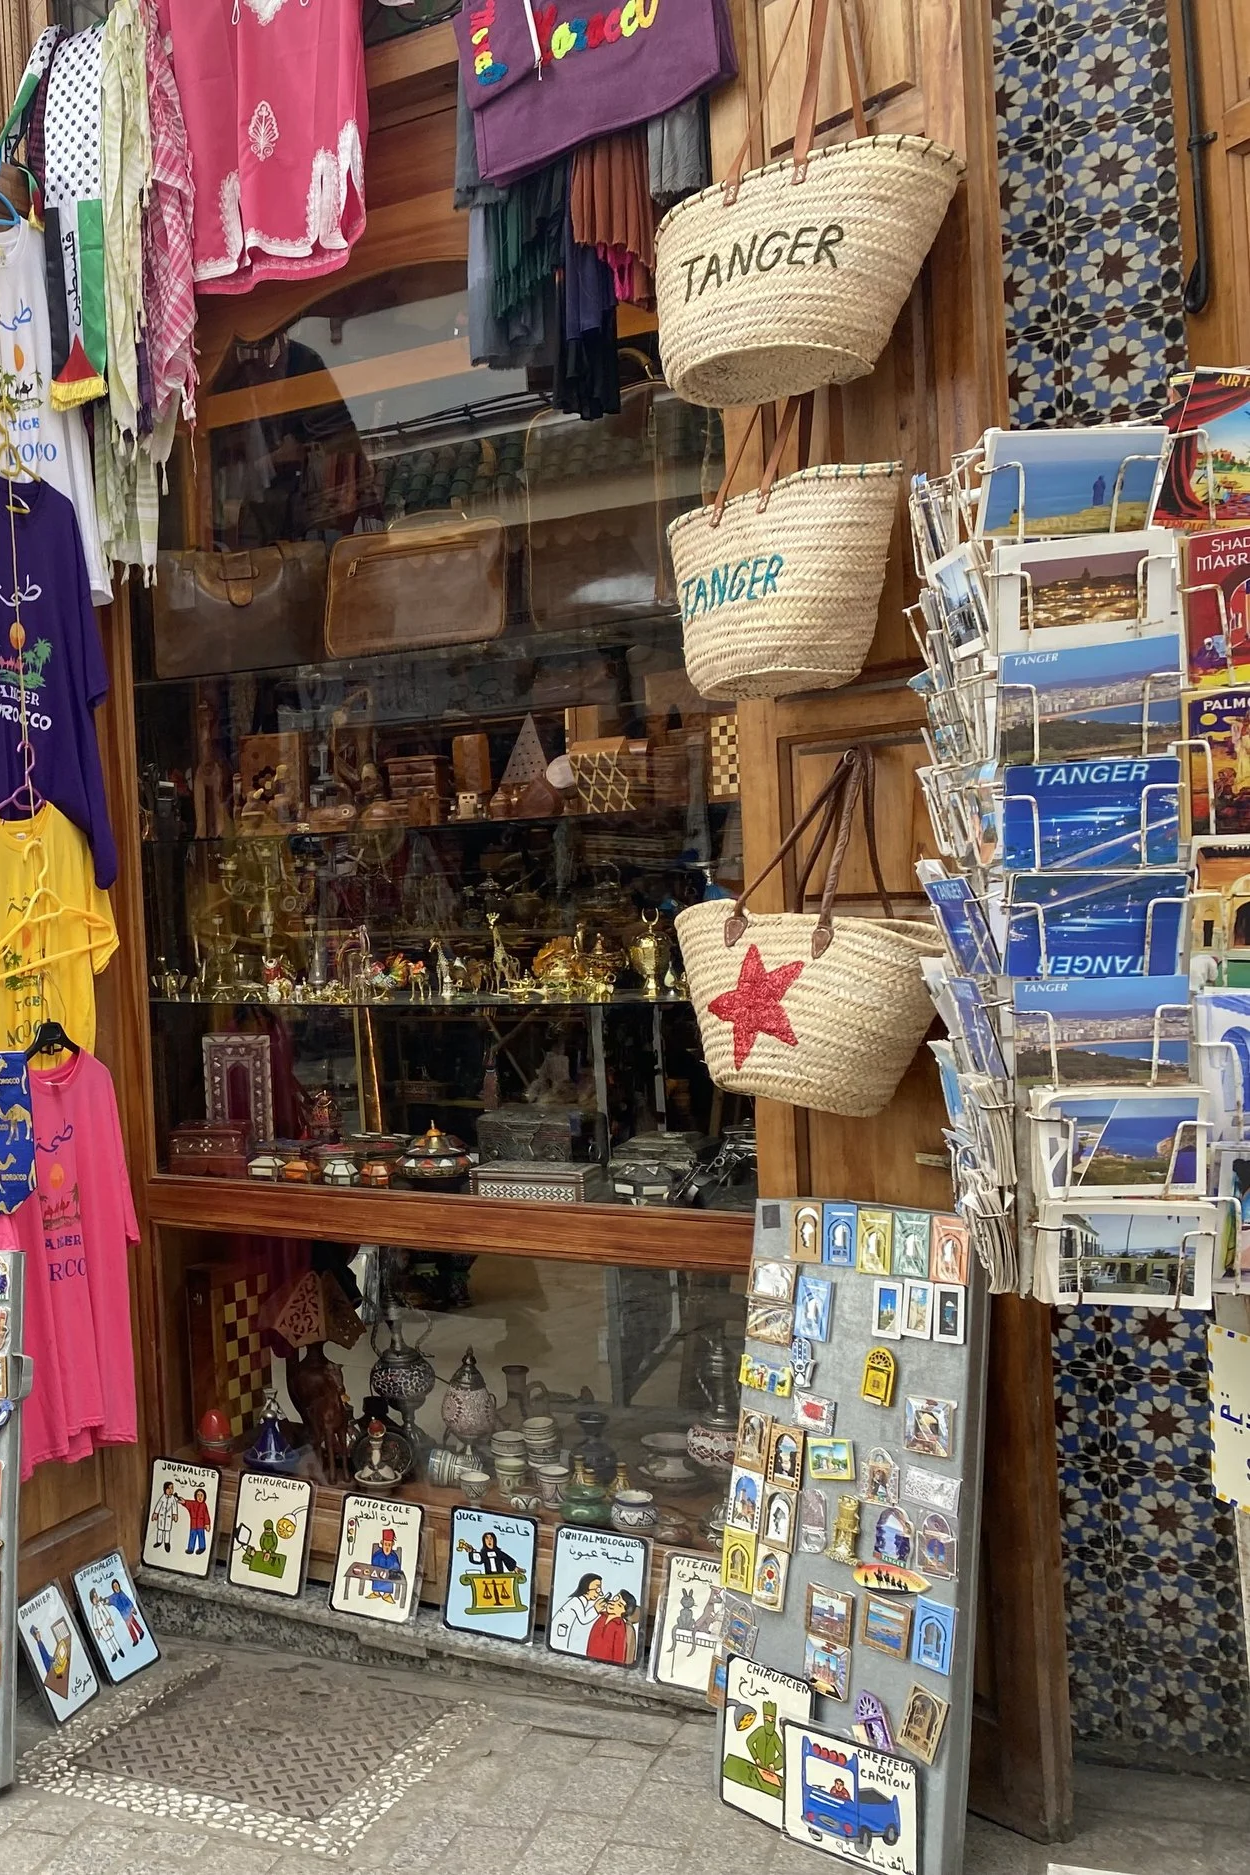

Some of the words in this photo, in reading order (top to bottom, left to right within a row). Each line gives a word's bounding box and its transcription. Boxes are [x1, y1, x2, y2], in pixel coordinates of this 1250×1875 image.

[680, 224, 844, 303] TANGER
[61, 230, 82, 327] فلسطين
[1215, 374, 1241, 387] AIR
[681, 553, 784, 623] TANGER
[1013, 653, 1059, 666] TANGER
[1034, 763, 1149, 787] TANGER
[932, 883, 964, 900] TANGER
[1036, 954, 1145, 977] TANGER
[1023, 983, 1068, 993] TANGER
[161, 1462, 217, 1479] JOURNALISTE
[455, 1511, 483, 1523] JUGE
[19, 1592, 52, 1620] DOUANIER
[857, 1749, 917, 1775] CHEFFEUR
[878, 1765, 894, 1778] DU
[860, 1768, 911, 1791] CAMION
